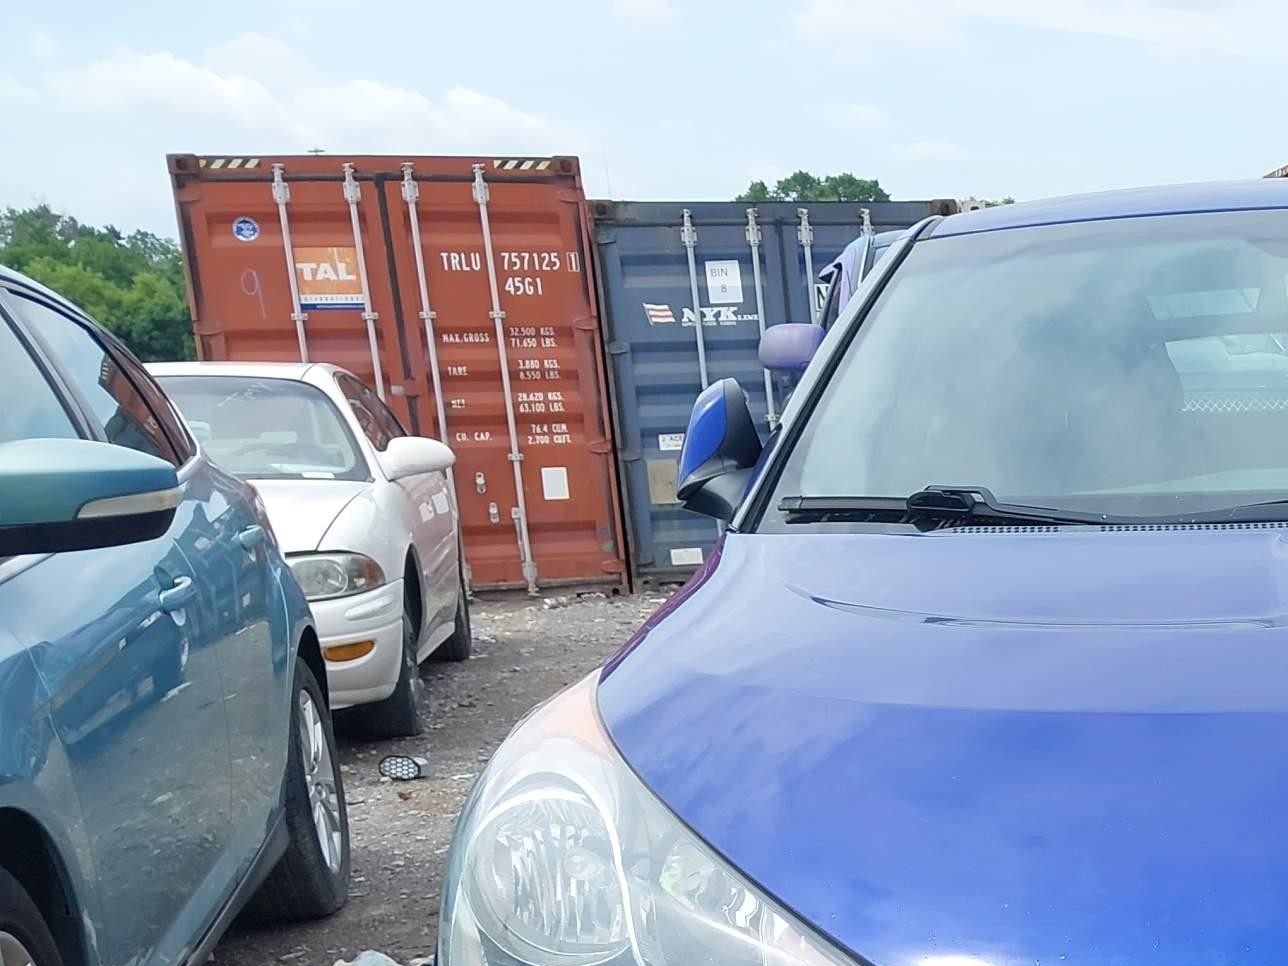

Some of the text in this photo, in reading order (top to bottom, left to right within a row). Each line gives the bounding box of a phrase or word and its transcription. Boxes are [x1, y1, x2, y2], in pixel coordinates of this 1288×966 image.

[440, 252, 481, 271] TRLU
[500, 252, 560, 271] 757125
[295, 262, 357, 281] TAL
[710, 267, 728, 277] BIN
[504, 277, 543, 295] 45G1
[720, 283, 728, 293] 8
[681, 306, 738, 323] NYK
